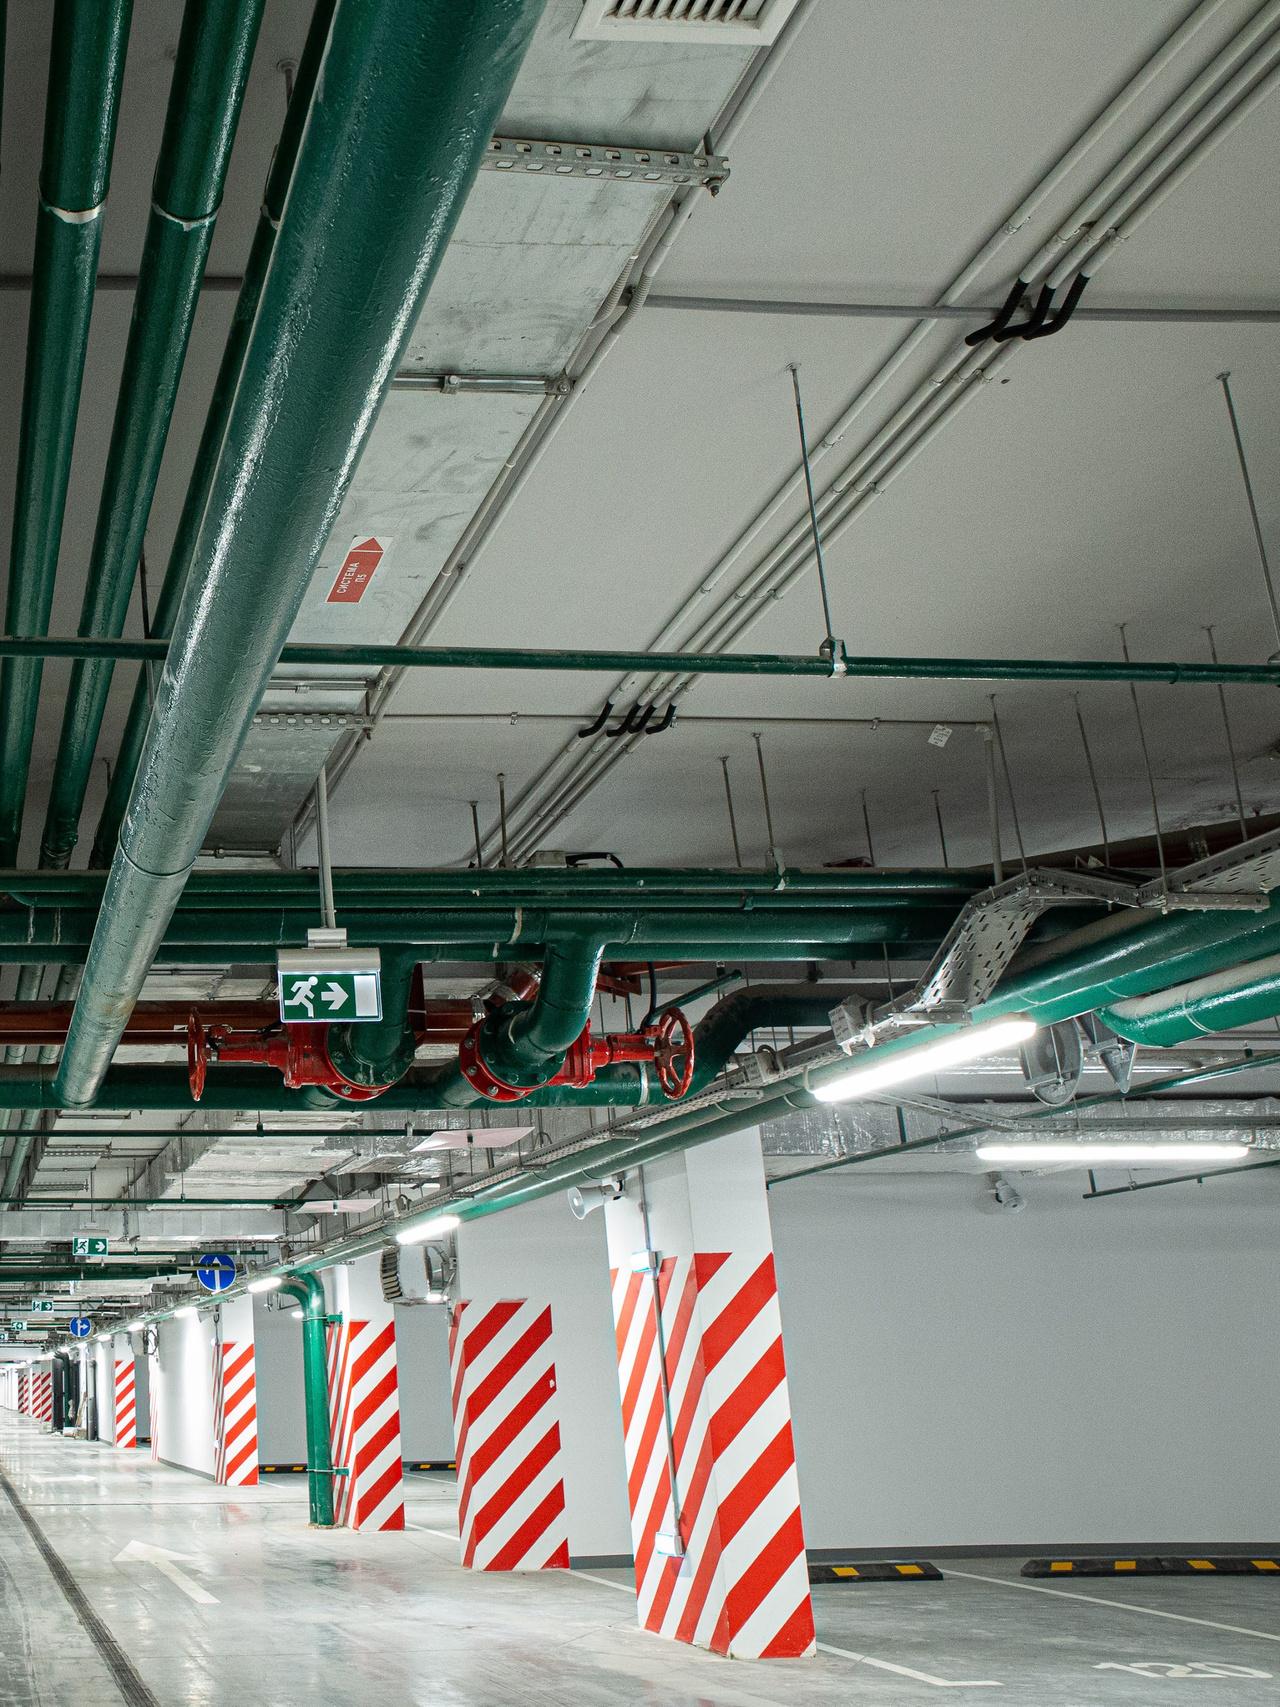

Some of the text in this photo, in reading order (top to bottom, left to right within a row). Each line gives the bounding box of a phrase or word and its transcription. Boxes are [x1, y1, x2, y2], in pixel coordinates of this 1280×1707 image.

[336, 562, 360, 594] СИСТЕМА
[355, 573, 367, 583] П5
[1091, 1661, 1274, 1679] 120
